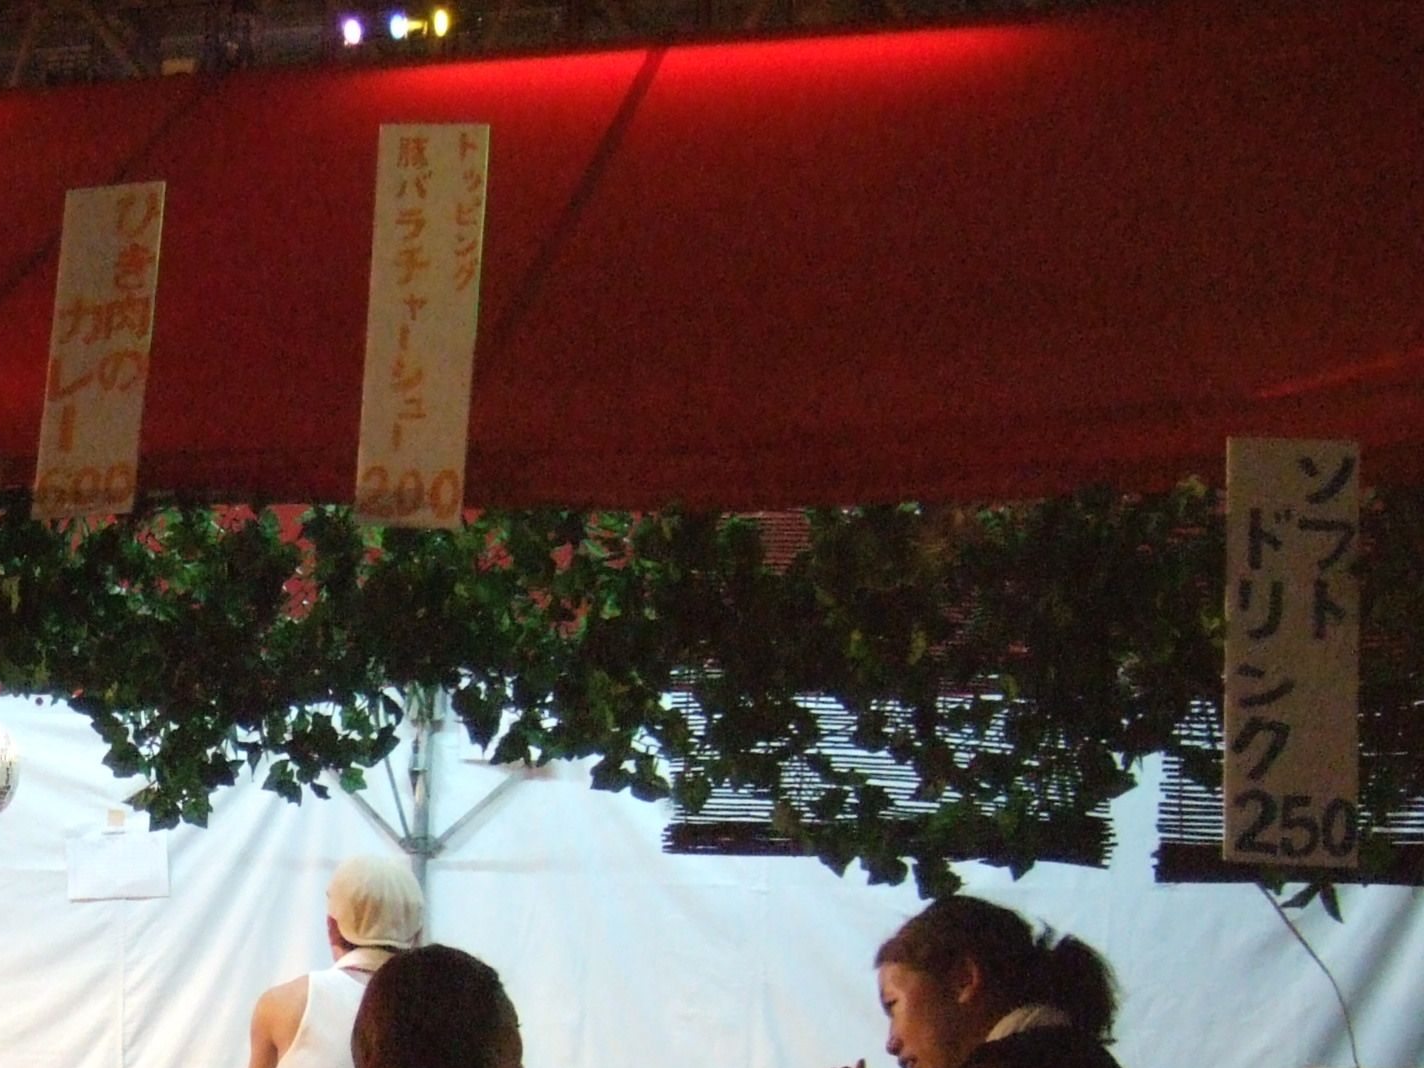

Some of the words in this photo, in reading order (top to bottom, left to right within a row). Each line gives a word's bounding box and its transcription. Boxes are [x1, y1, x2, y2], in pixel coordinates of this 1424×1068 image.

[45, 298, 112, 451] カレー
[361, 464, 462, 522] 200
[1297, 456, 1357, 640] ソフト
[1230, 507, 1296, 781] ドリンク
[1234, 786, 1357, 858] 250
